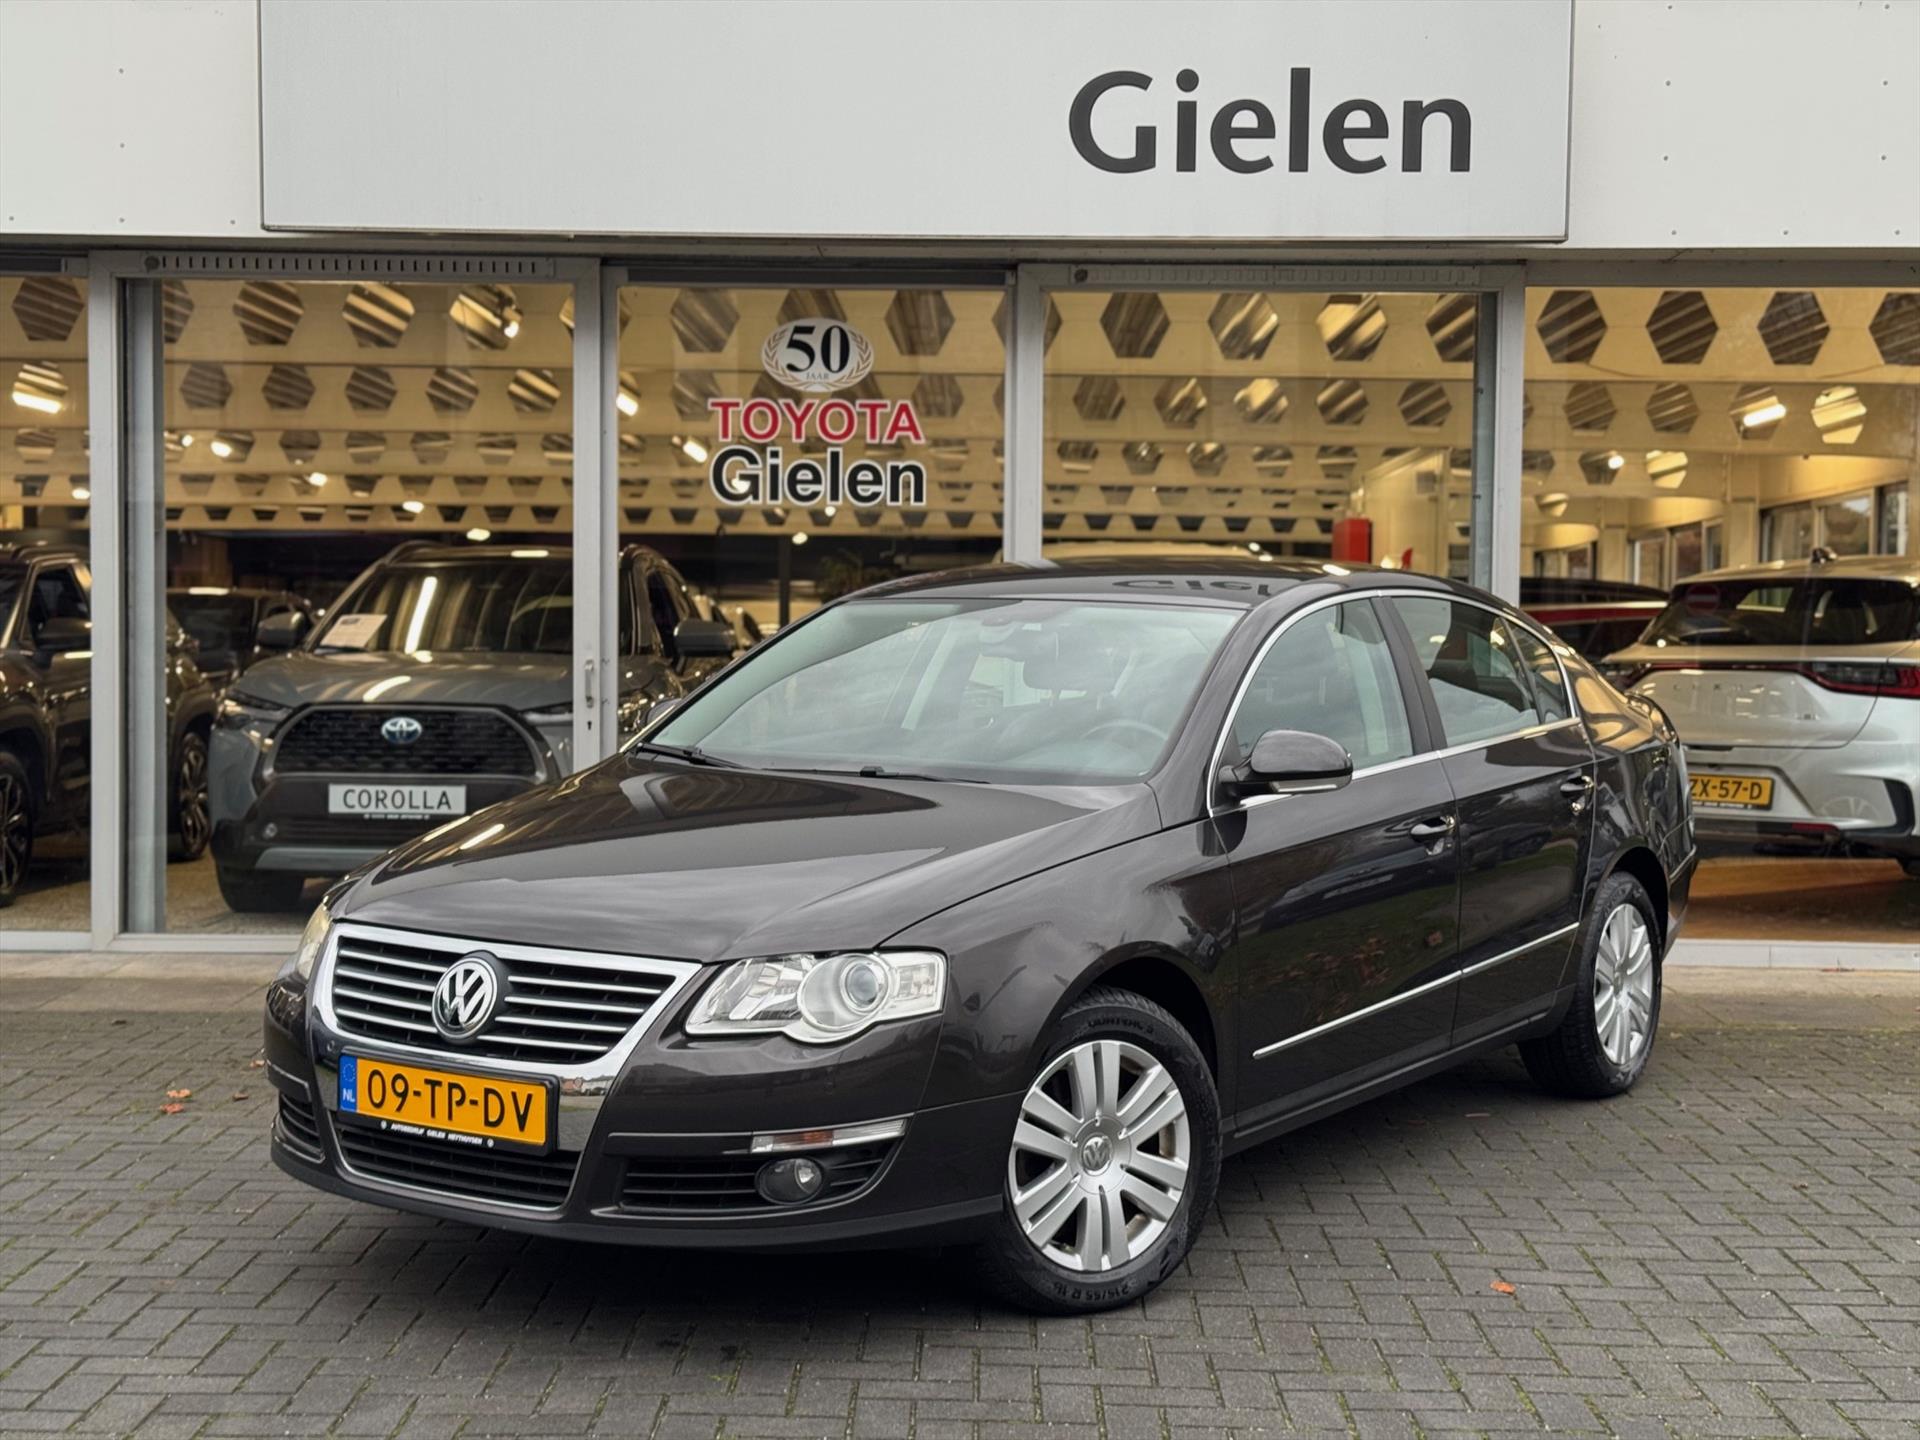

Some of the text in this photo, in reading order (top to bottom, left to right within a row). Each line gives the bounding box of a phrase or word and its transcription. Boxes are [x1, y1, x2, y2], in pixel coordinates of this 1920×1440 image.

[1069, 67, 1472, 174] Gielen
[786, 325, 850, 373] 50
[708, 399, 924, 443] TOYOTA
[711, 446, 926, 505] Gielen
[343, 789, 452, 810] COROLLA
[436, 960, 495, 1033] VW
[342, 1088, 356, 1103] NL
[367, 1069, 534, 1133] 09-TP-DV
